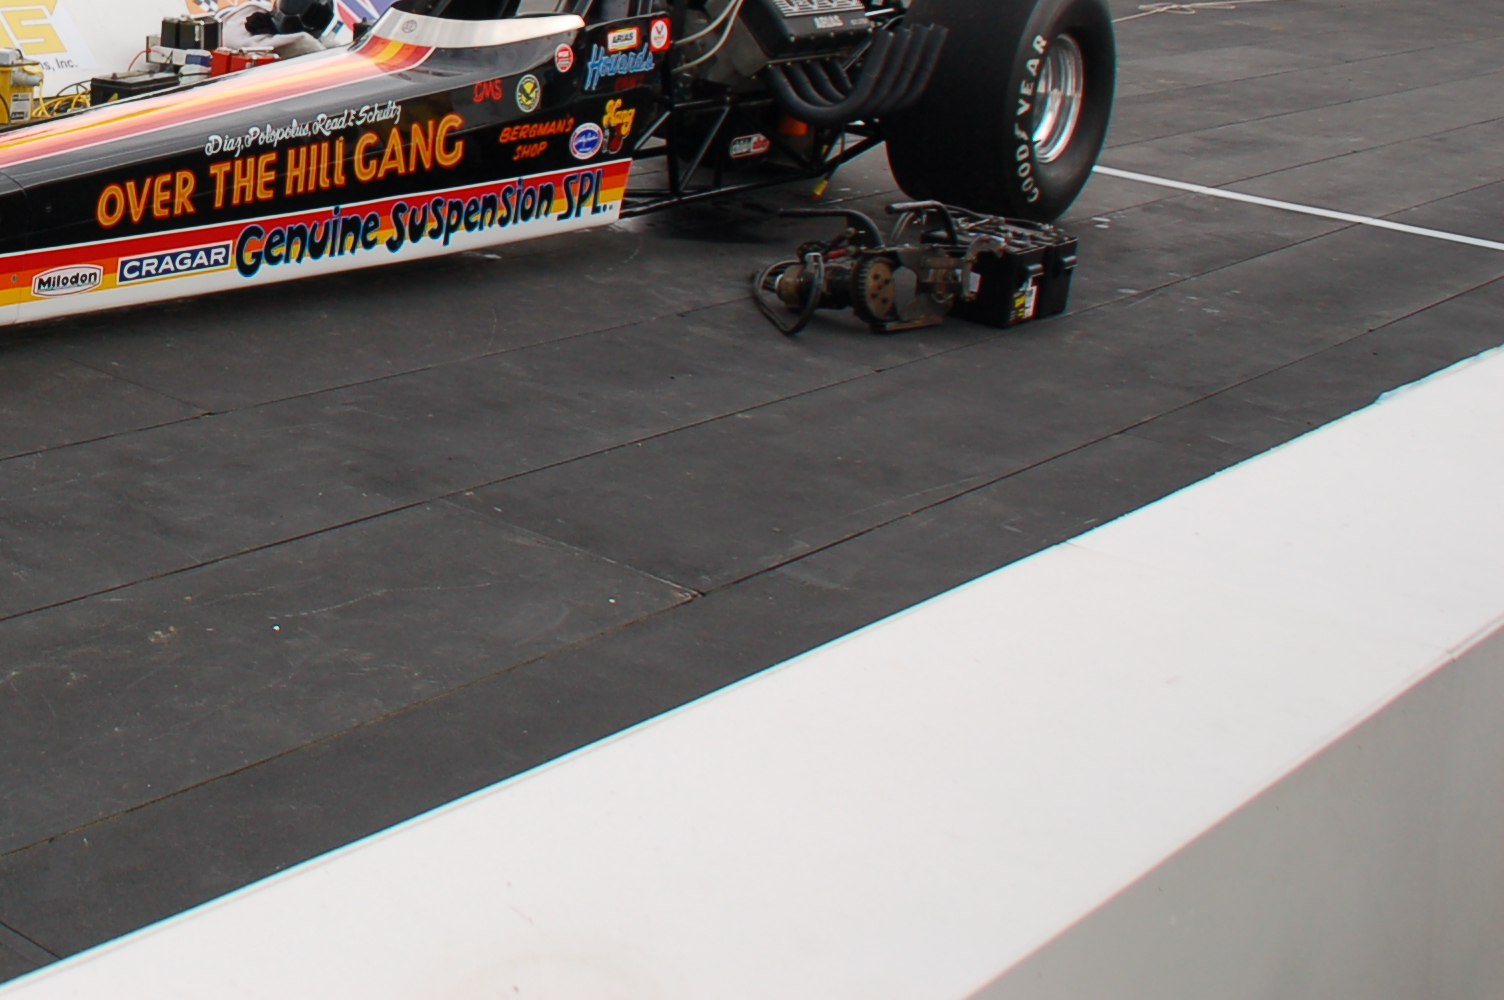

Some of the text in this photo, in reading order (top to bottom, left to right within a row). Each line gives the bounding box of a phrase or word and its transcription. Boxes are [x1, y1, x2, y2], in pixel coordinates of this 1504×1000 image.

[56, 58, 78, 69] Inc.
[313, 109, 347, 137] Read
[356, 100, 401, 124] Schultz
[499, 114, 575, 143] BERGMAN'S
[513, 141, 548, 160] SHOP
[96, 169, 196, 229] OVER
[209, 151, 278, 209] THE
[353, 113, 465, 183] GANG
[234, 206, 382, 278] Genuine
[123, 247, 226, 279] CRAGAR
[37, 271, 97, 291] Milodon
